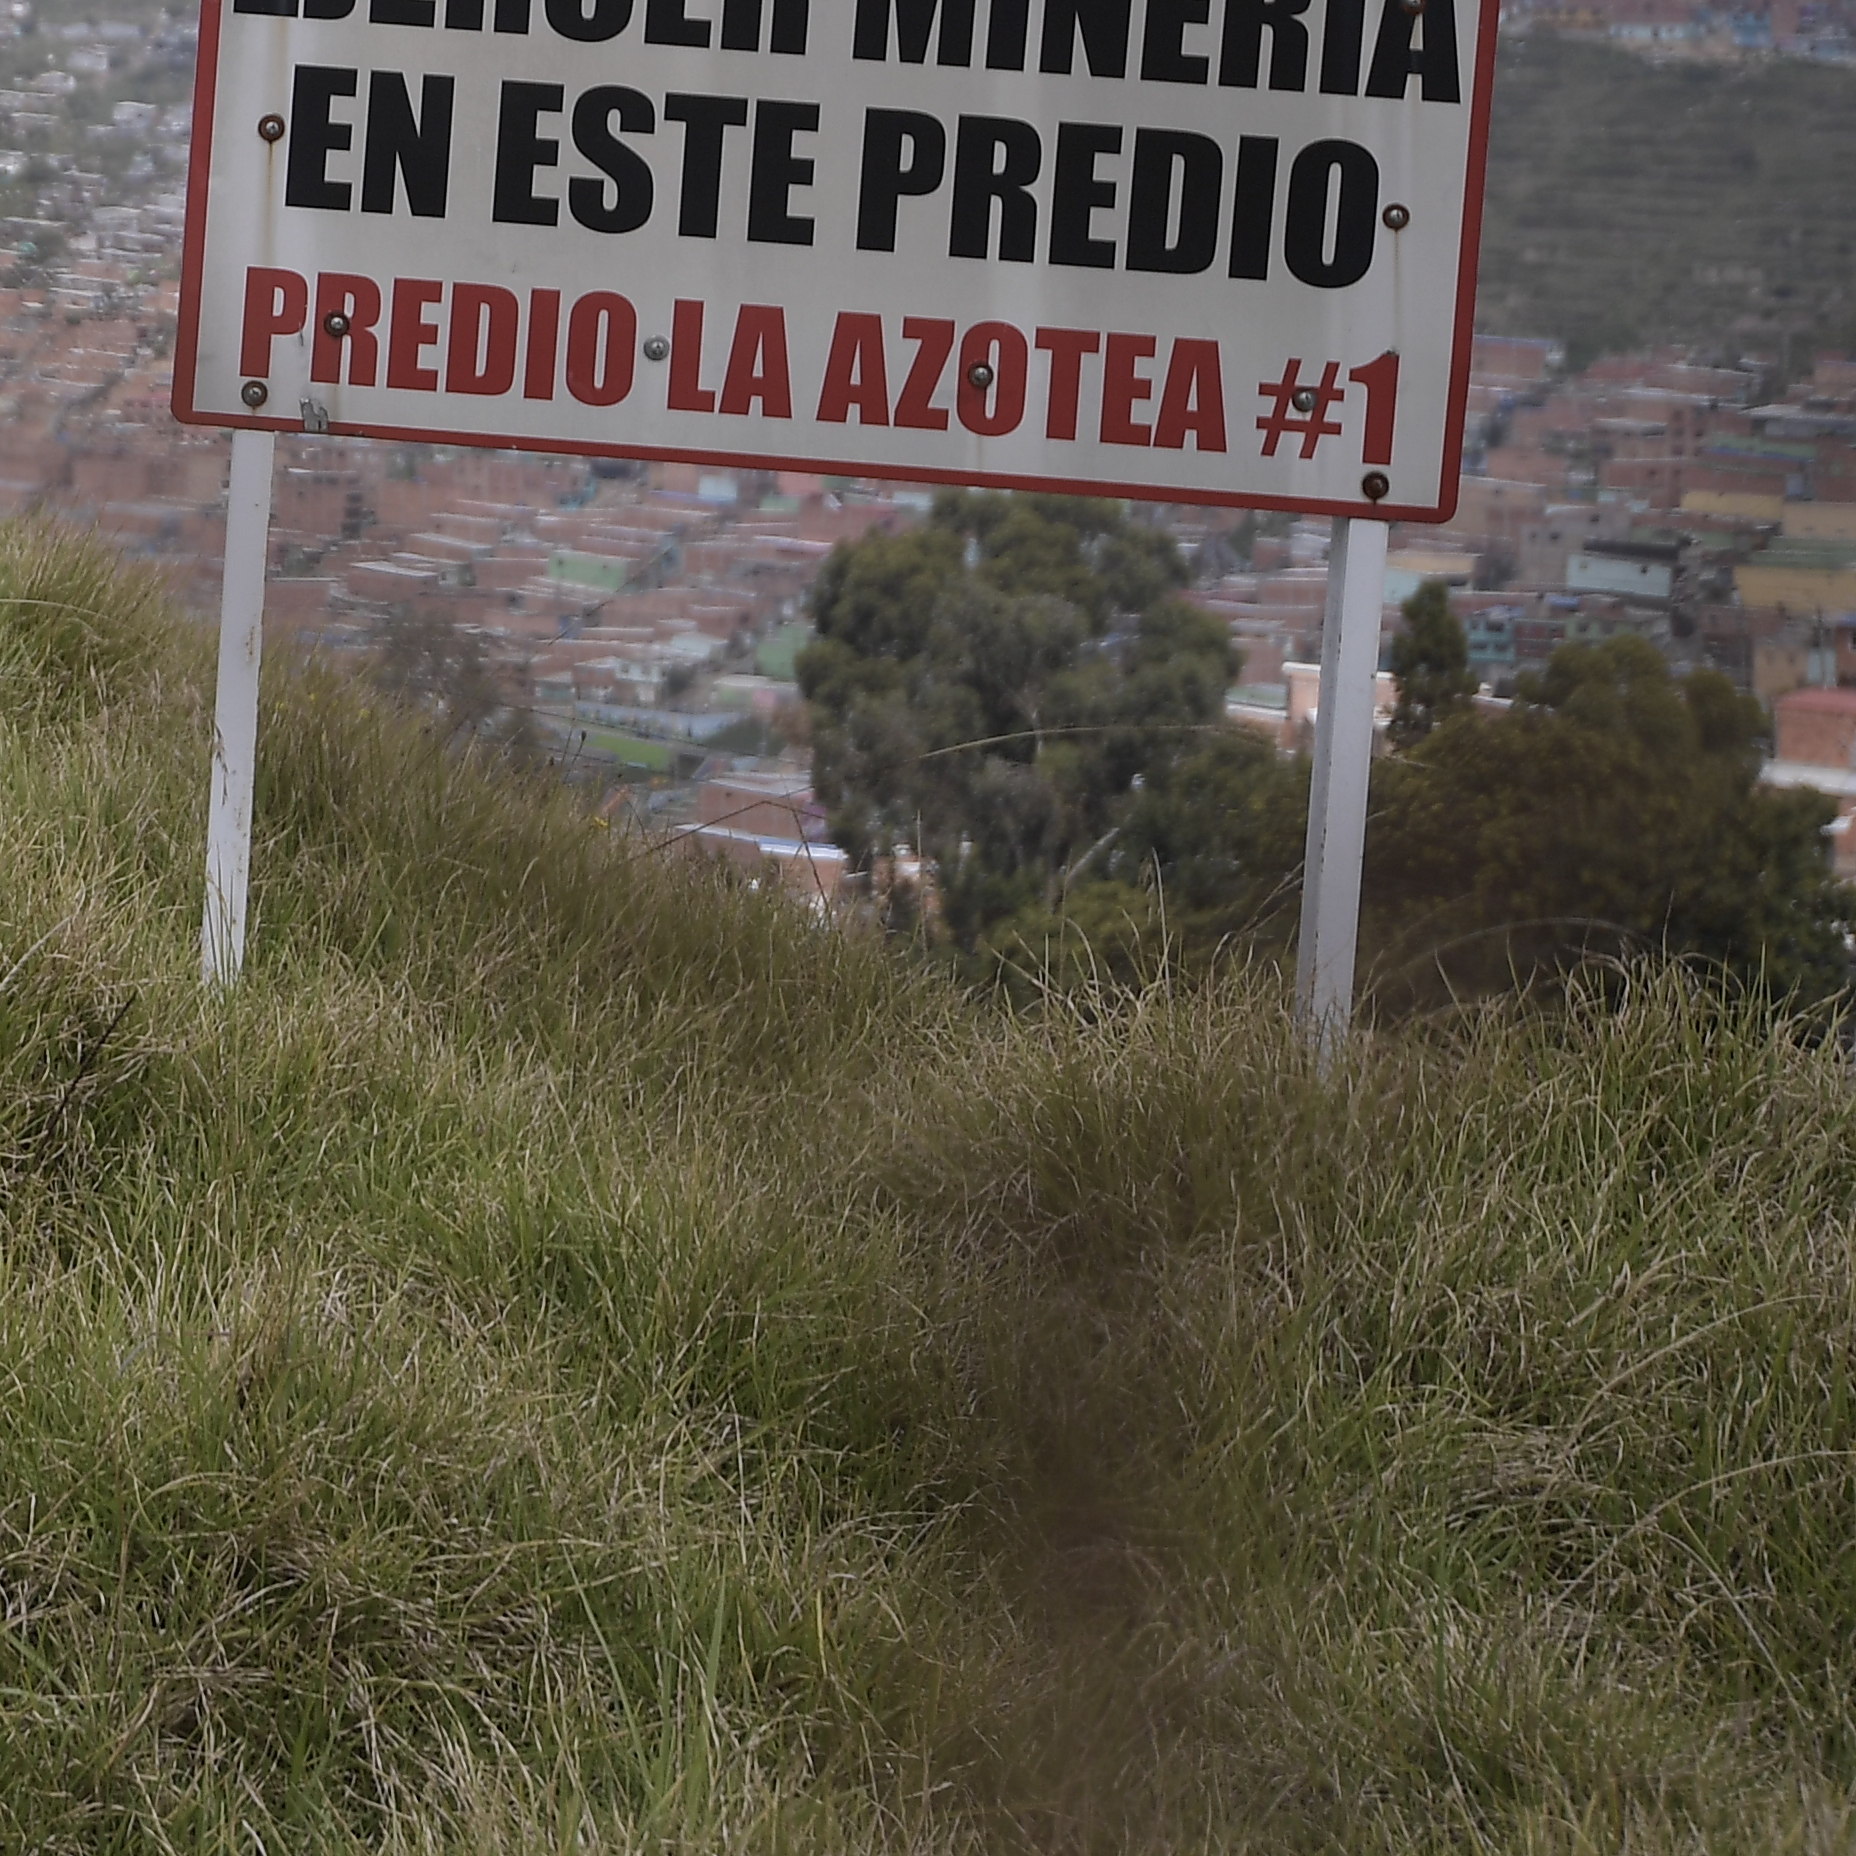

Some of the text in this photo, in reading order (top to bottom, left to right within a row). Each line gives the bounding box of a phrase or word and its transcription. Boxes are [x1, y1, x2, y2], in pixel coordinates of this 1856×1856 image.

[285, 63, 1380, 289] EN ESTE PREDIO
[240, 266, 1399, 466] PREDIO LA AZOTEA #1
